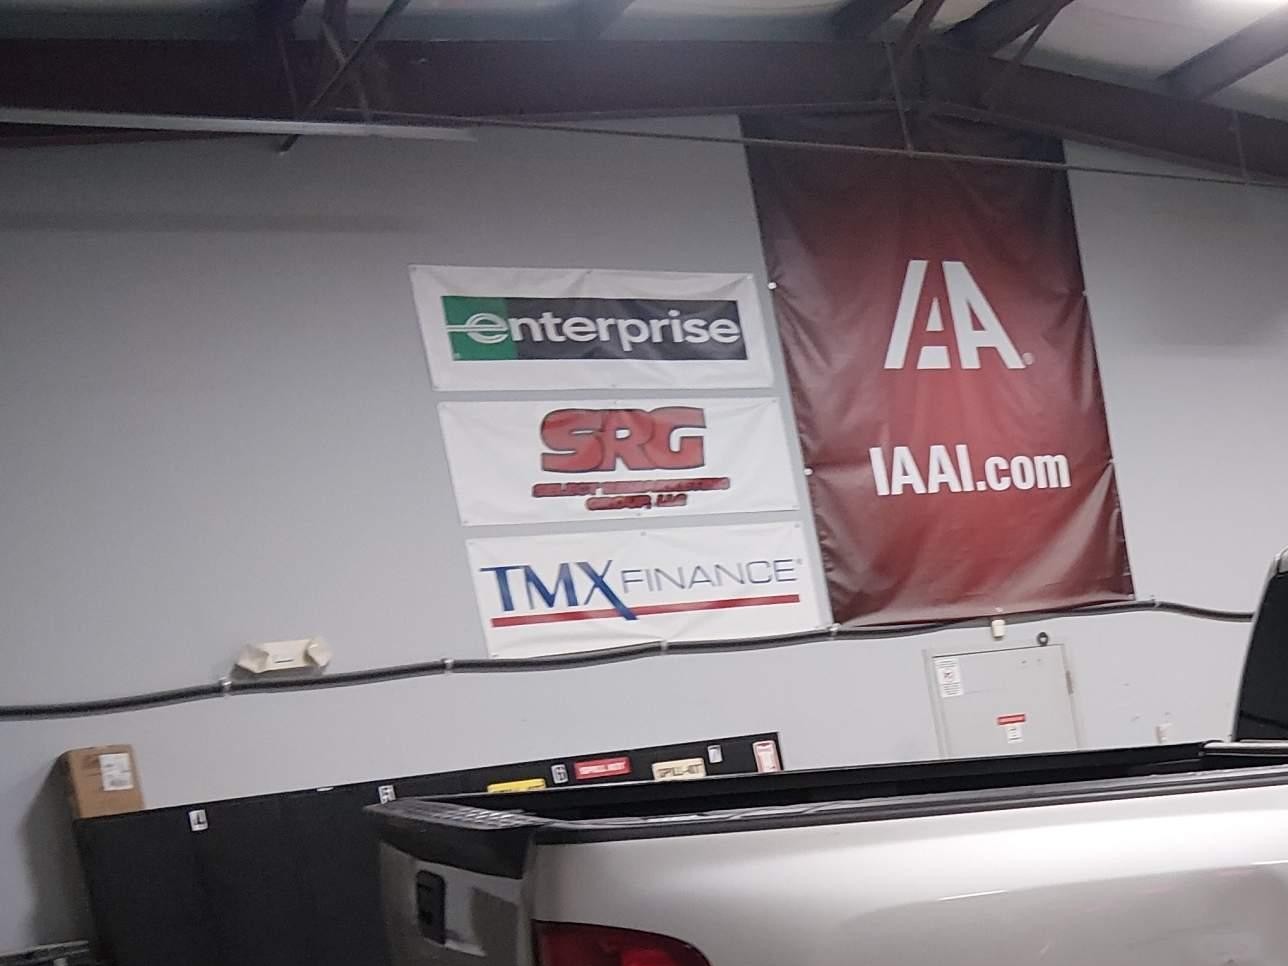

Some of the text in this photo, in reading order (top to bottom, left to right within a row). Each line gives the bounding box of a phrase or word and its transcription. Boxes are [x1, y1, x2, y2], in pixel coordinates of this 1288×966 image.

[448, 309, 741, 352] enterprise
[540, 406, 707, 473] SRG
[869, 444, 1072, 496] IAAI.com
[480, 559, 798, 621] TMX FINANCE
